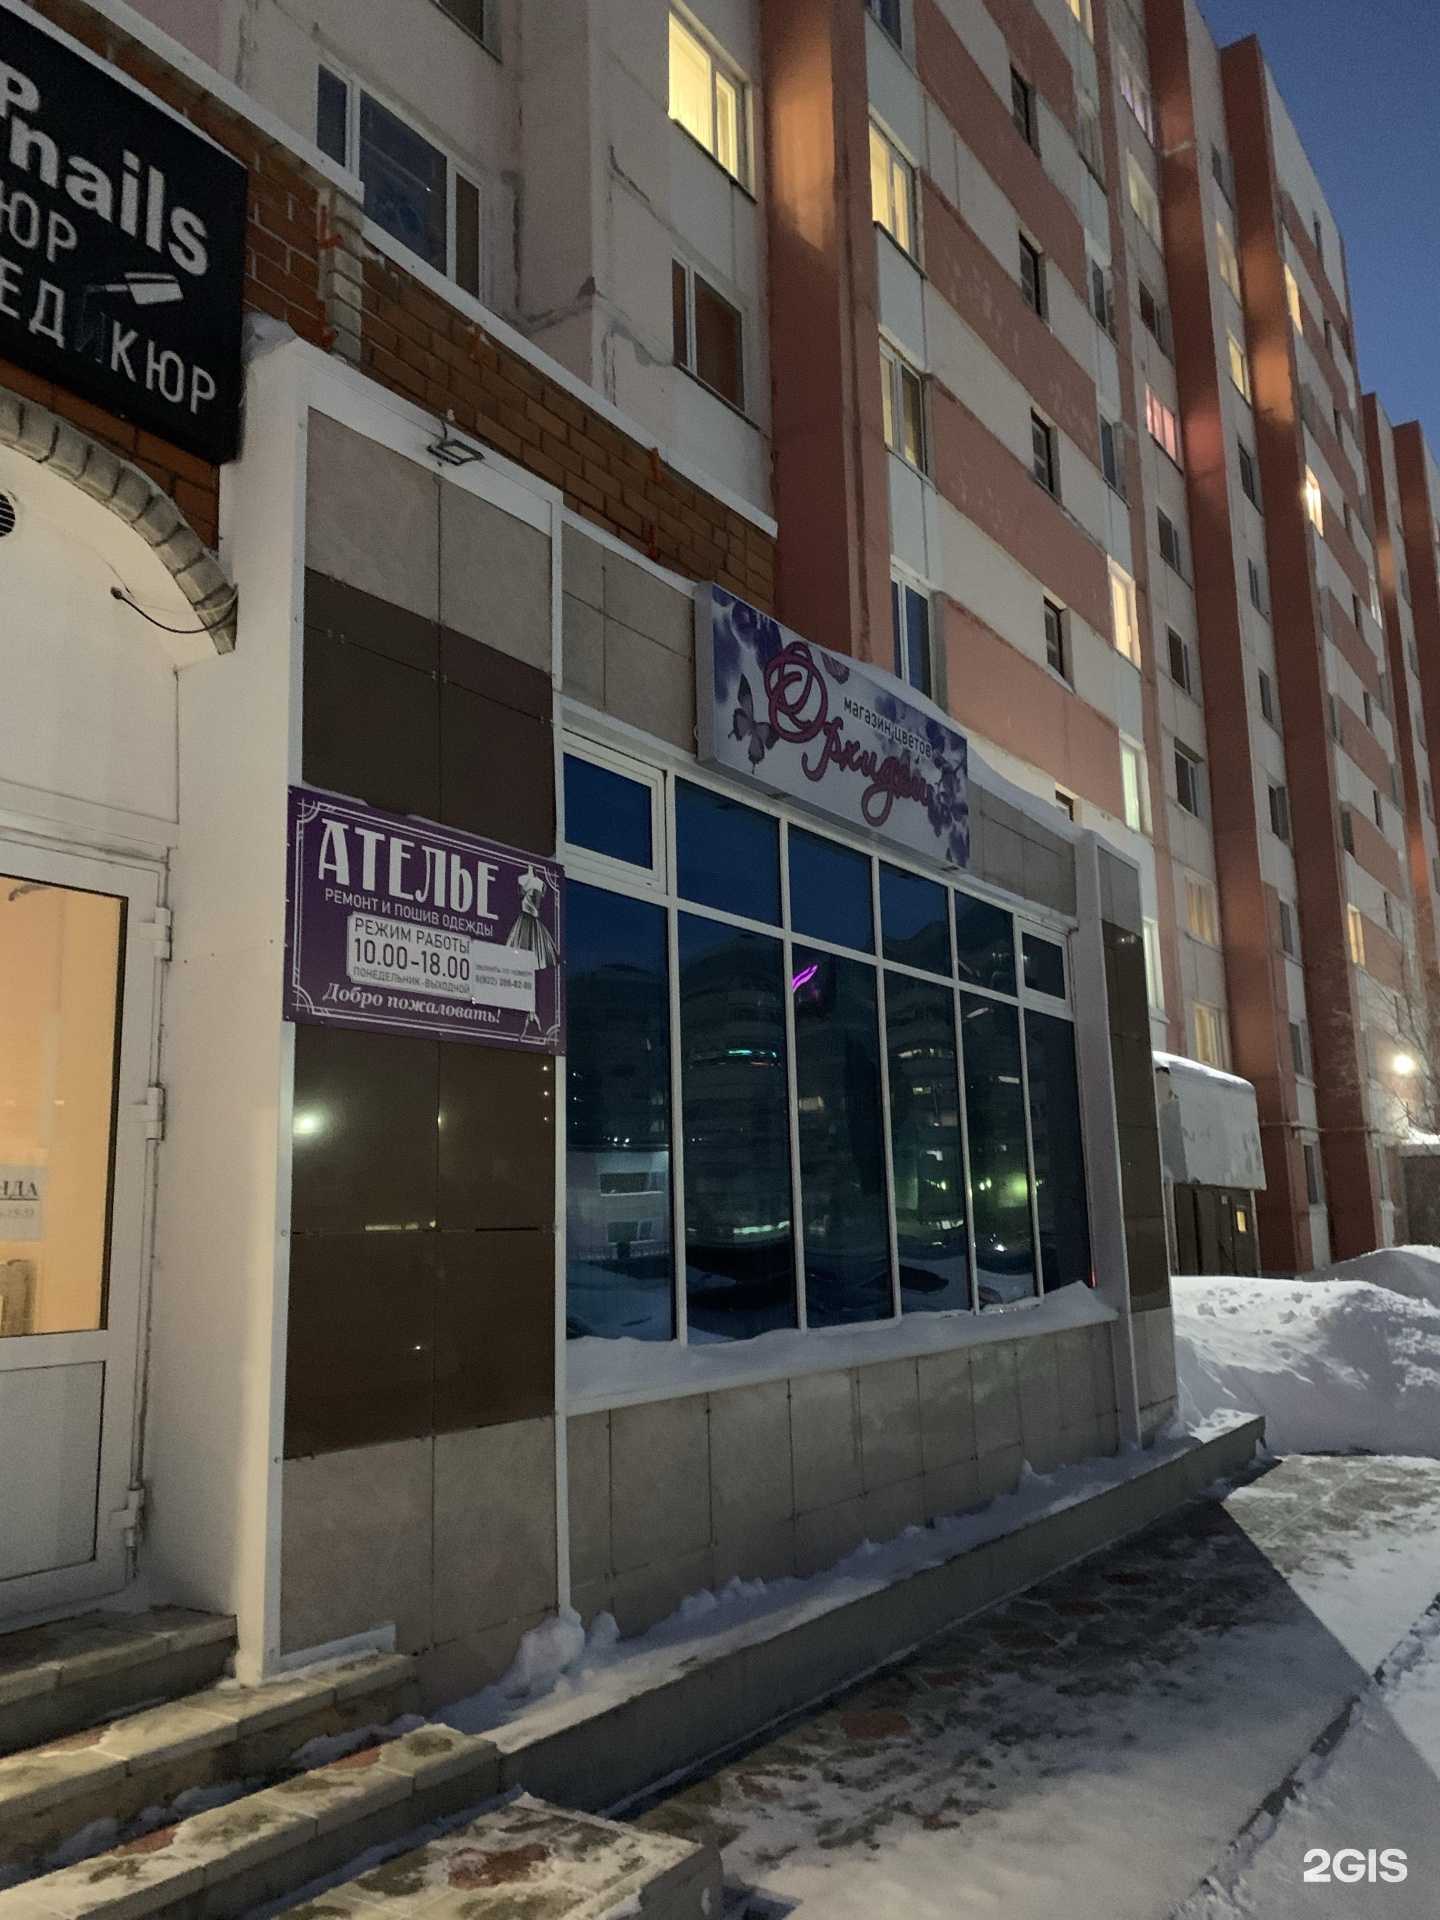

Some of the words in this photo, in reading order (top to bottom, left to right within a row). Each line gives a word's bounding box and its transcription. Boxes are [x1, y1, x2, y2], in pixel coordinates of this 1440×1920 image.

[9, 114, 208, 277] nails
[844, 697, 891, 738] магазин
[894, 730, 933, 758] цветов
[318, 818, 499, 920] АТЕЛЬЕ
[325, 888, 379, 911] РЕМОНТ
[382, 902, 391, 914] И
[394, 904, 440, 925] ПОШИВ
[442, 916, 493, 936] ОДЕЖДЫ
[354, 917, 411, 942] РЕЖИМ
[416, 930, 470, 954] РАБОТЫ
[353, 966, 421, 985] ПОНЕДЕЛЬНИК
[354, 938, 470, 981] 10.00-18.00
[322, 983, 383, 1008] Добро
[387, 995, 502, 1024] пожаловать!
